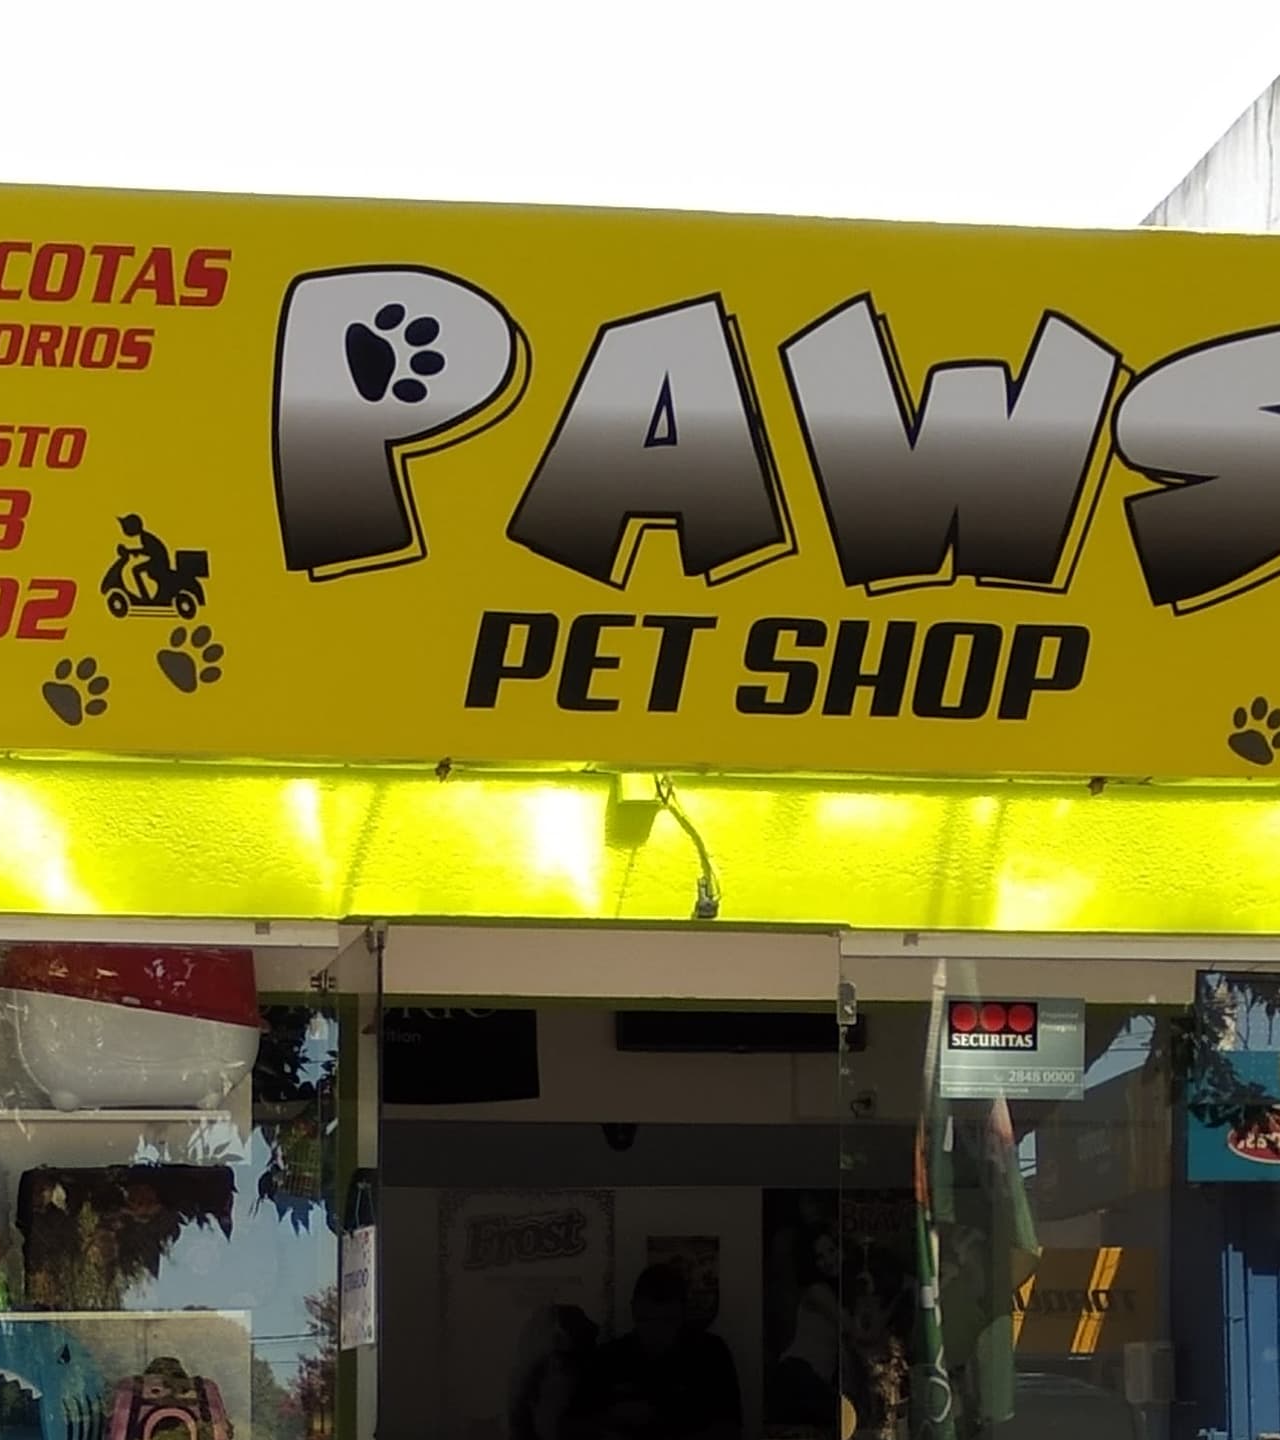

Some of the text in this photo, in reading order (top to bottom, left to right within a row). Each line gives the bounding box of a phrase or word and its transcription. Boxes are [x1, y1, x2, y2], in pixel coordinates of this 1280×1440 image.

[464, 610, 1090, 721] PET SHOP
[952, 1033, 1033, 1048] SECURITAS
